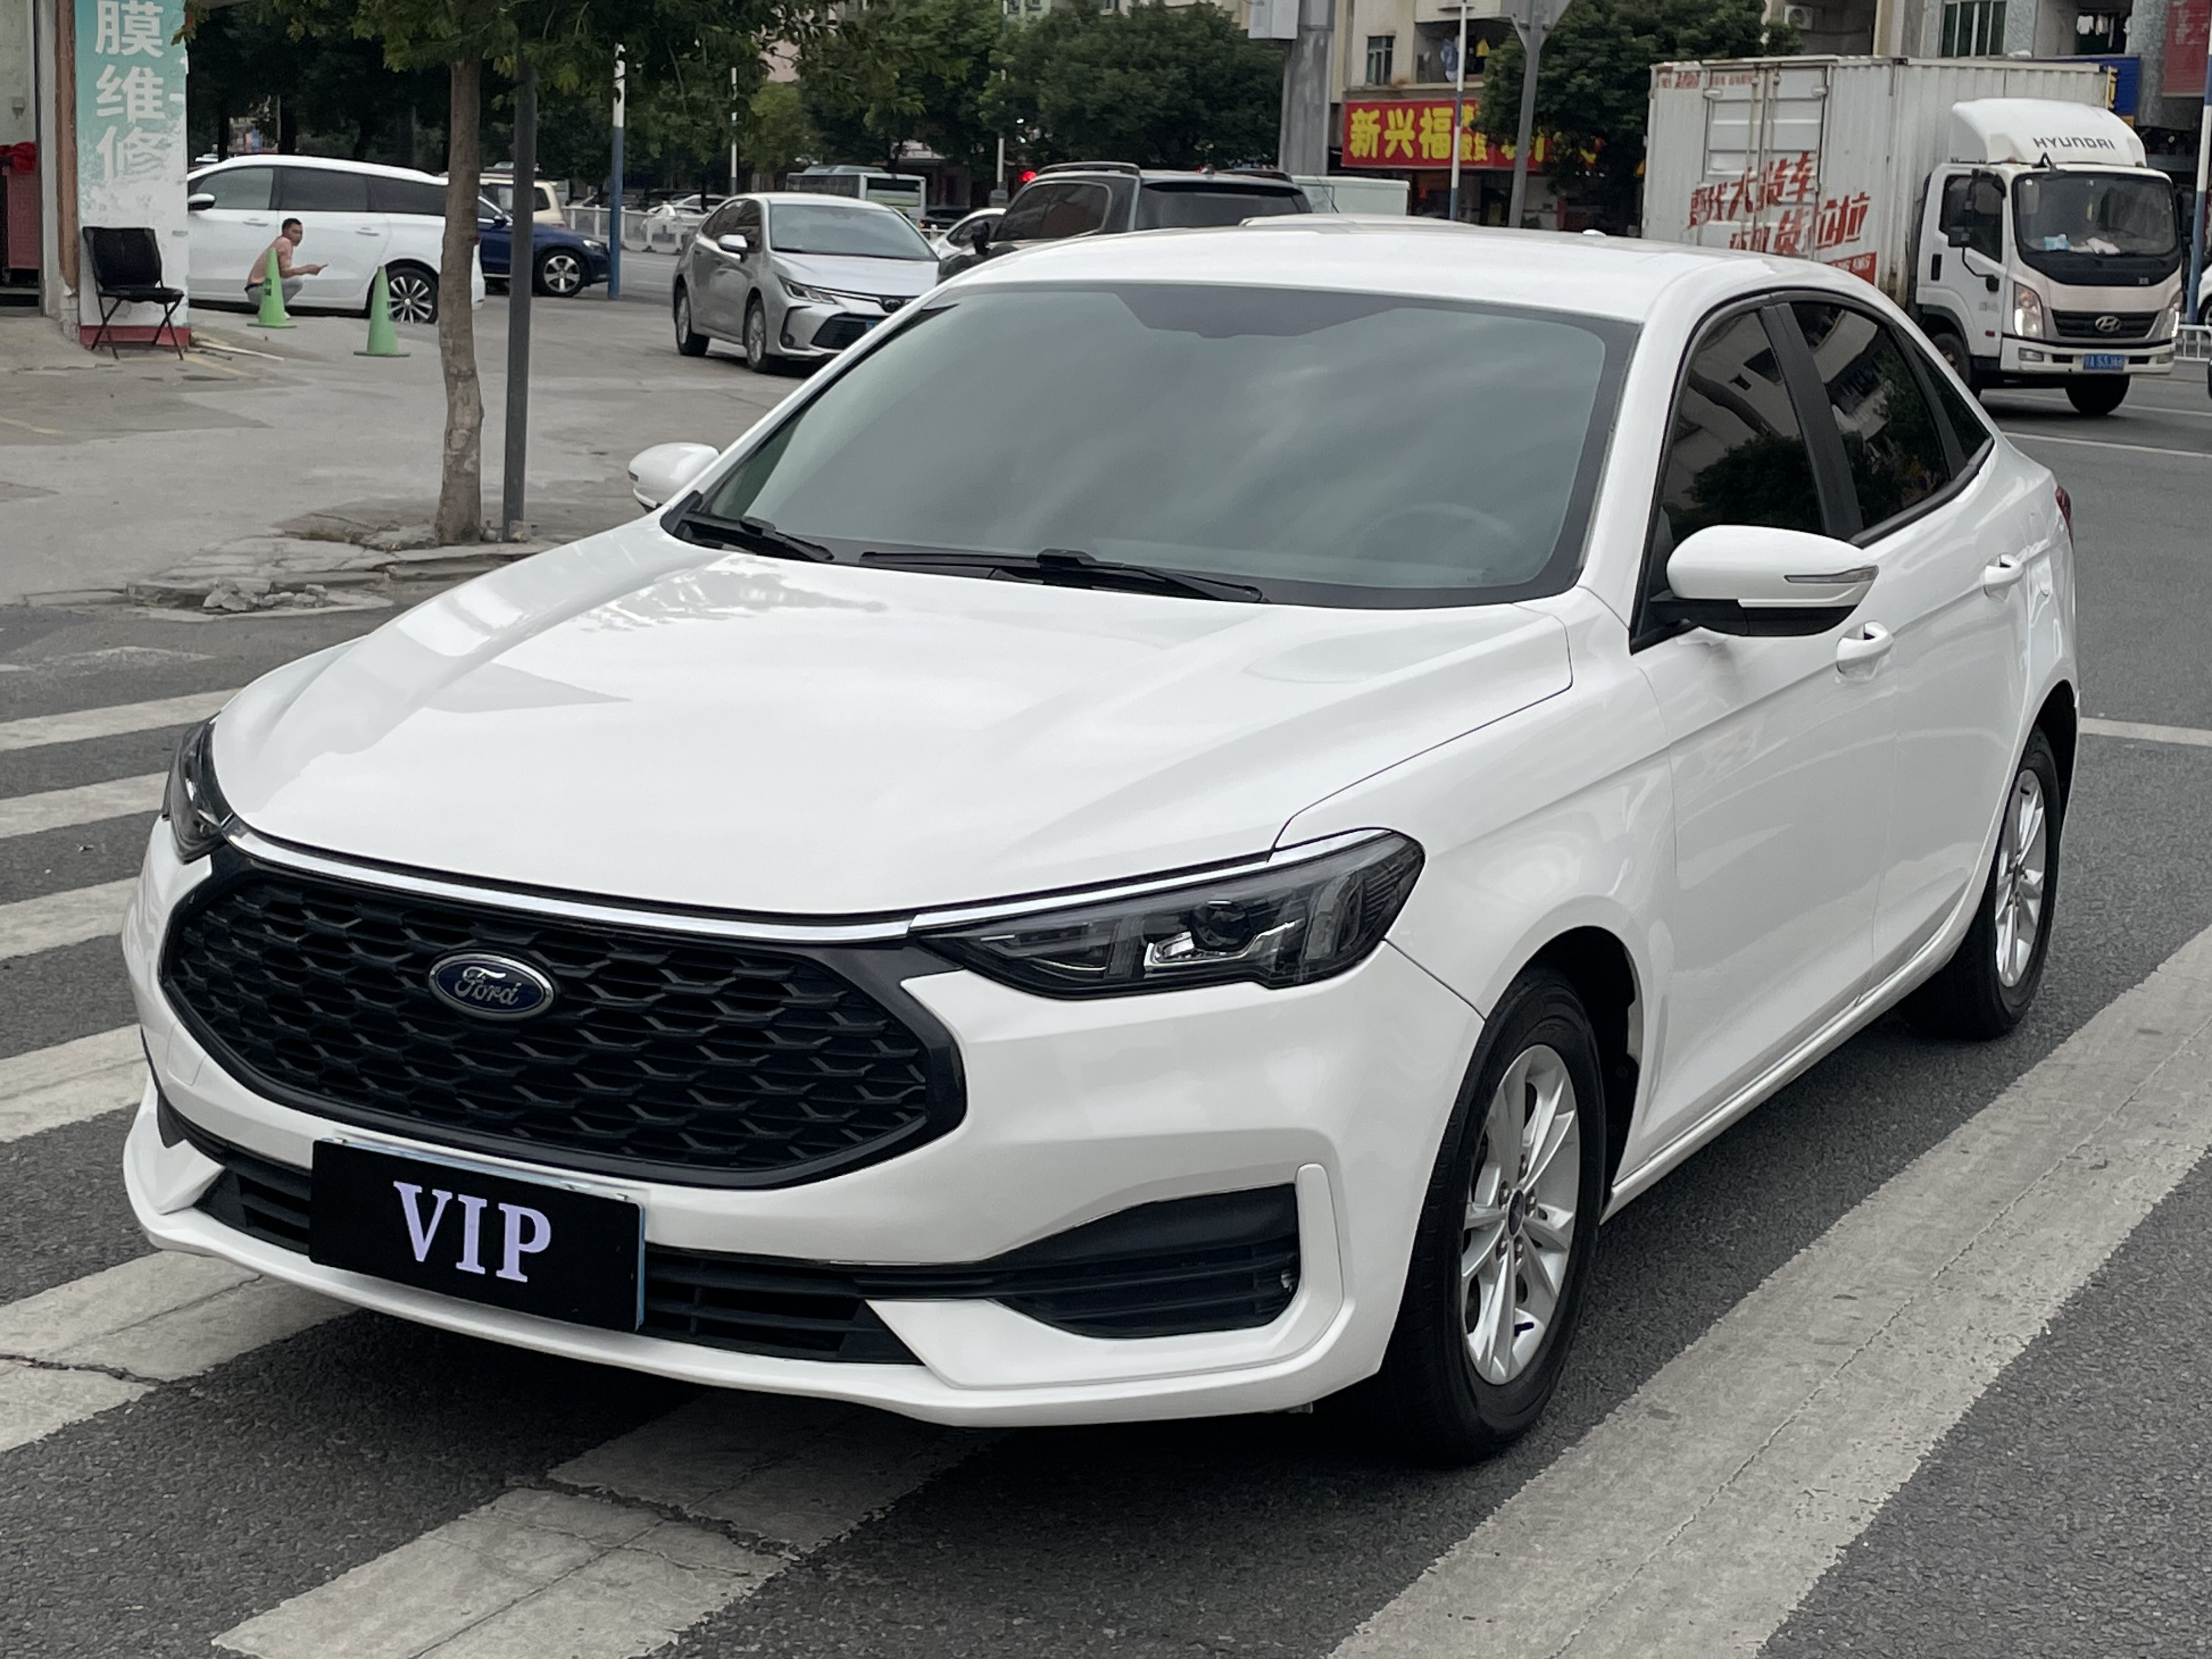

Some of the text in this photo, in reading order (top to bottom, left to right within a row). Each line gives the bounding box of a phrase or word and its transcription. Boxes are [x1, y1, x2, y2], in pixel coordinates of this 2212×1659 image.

[95, 1, 166, 188] 膜维修
[2033, 137, 2116, 150] HYUNDAI
[454, 966, 522, 1005] Ford
[393, 1180, 552, 1283] VIP
